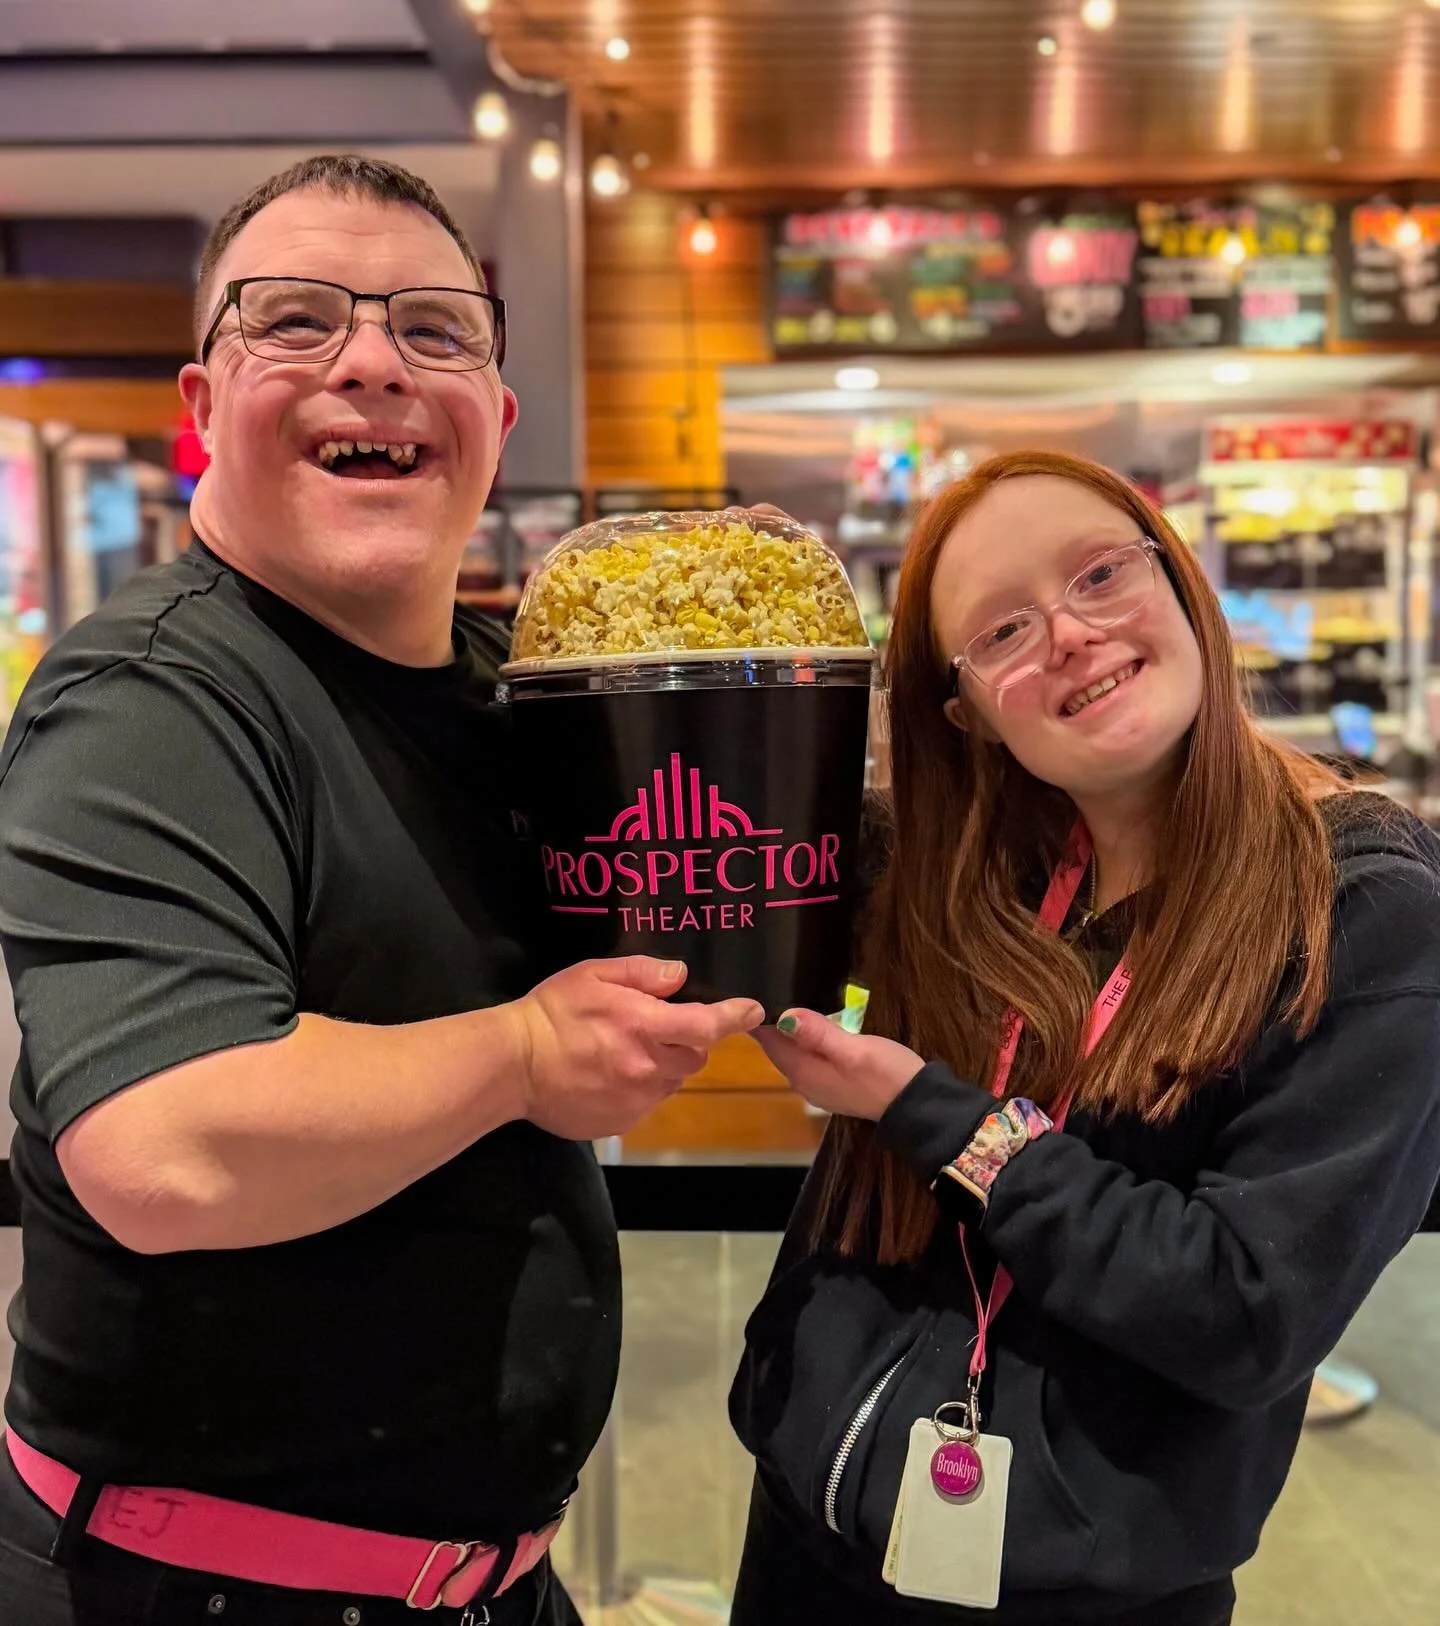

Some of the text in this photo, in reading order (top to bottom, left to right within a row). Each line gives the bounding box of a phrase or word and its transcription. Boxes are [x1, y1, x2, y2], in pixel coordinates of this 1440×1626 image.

[542, 834, 839, 896] PROSPECTOR
[618, 904, 754, 932] THEATER
[1102, 980, 1127, 1007] THE
[937, 1454, 978, 1485] Brooklyn
[109, 1489, 187, 1538] EJ
